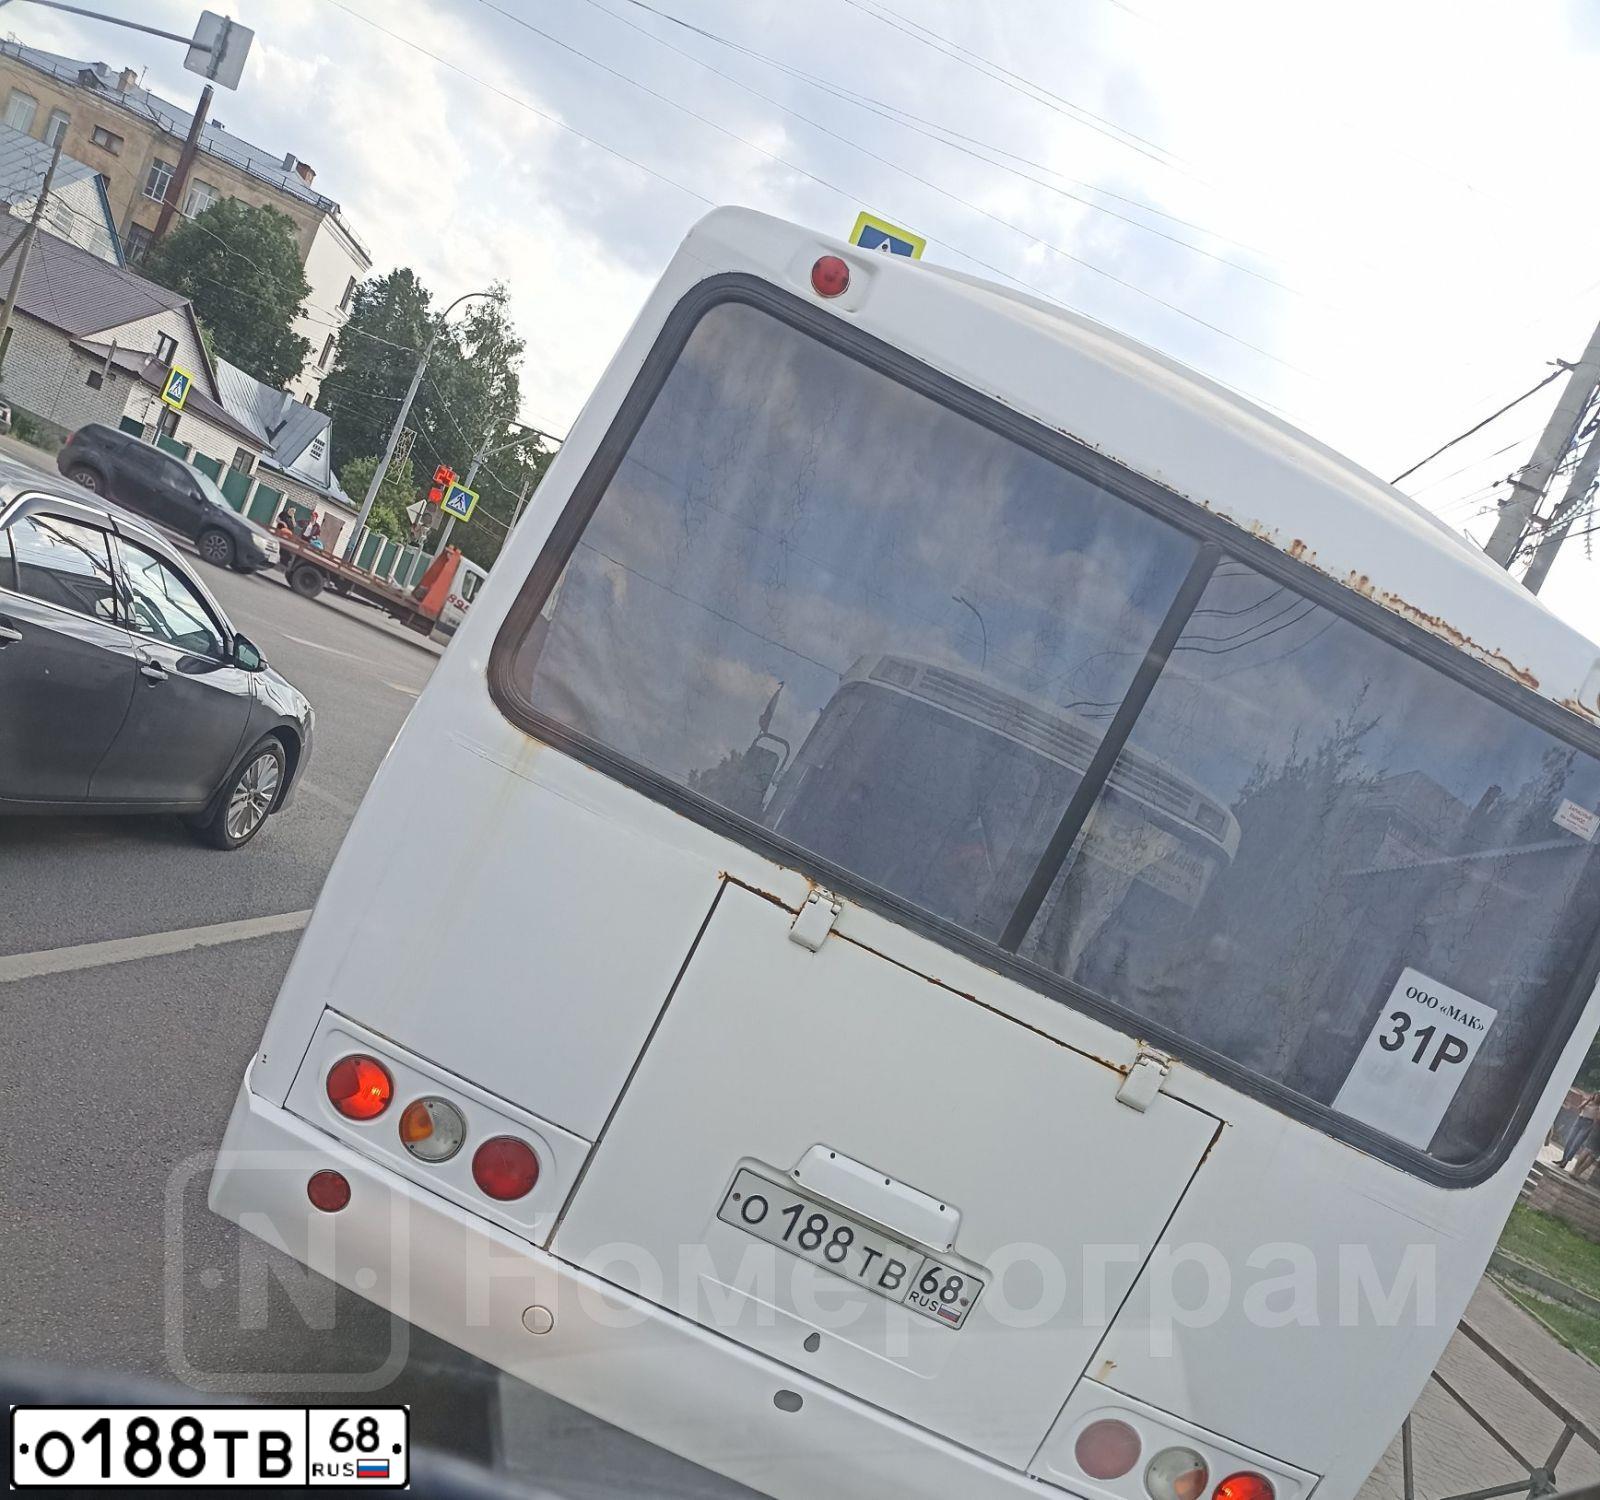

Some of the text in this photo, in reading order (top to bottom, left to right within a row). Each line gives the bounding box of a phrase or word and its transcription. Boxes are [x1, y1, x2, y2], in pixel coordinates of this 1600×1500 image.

[1405, 986, 1485, 1032] ООО «МАК»
[1379, 1011, 1469, 1073] 31Р
[908, 1291, 939, 1312] RUS
[919, 1266, 964, 1304] 68
